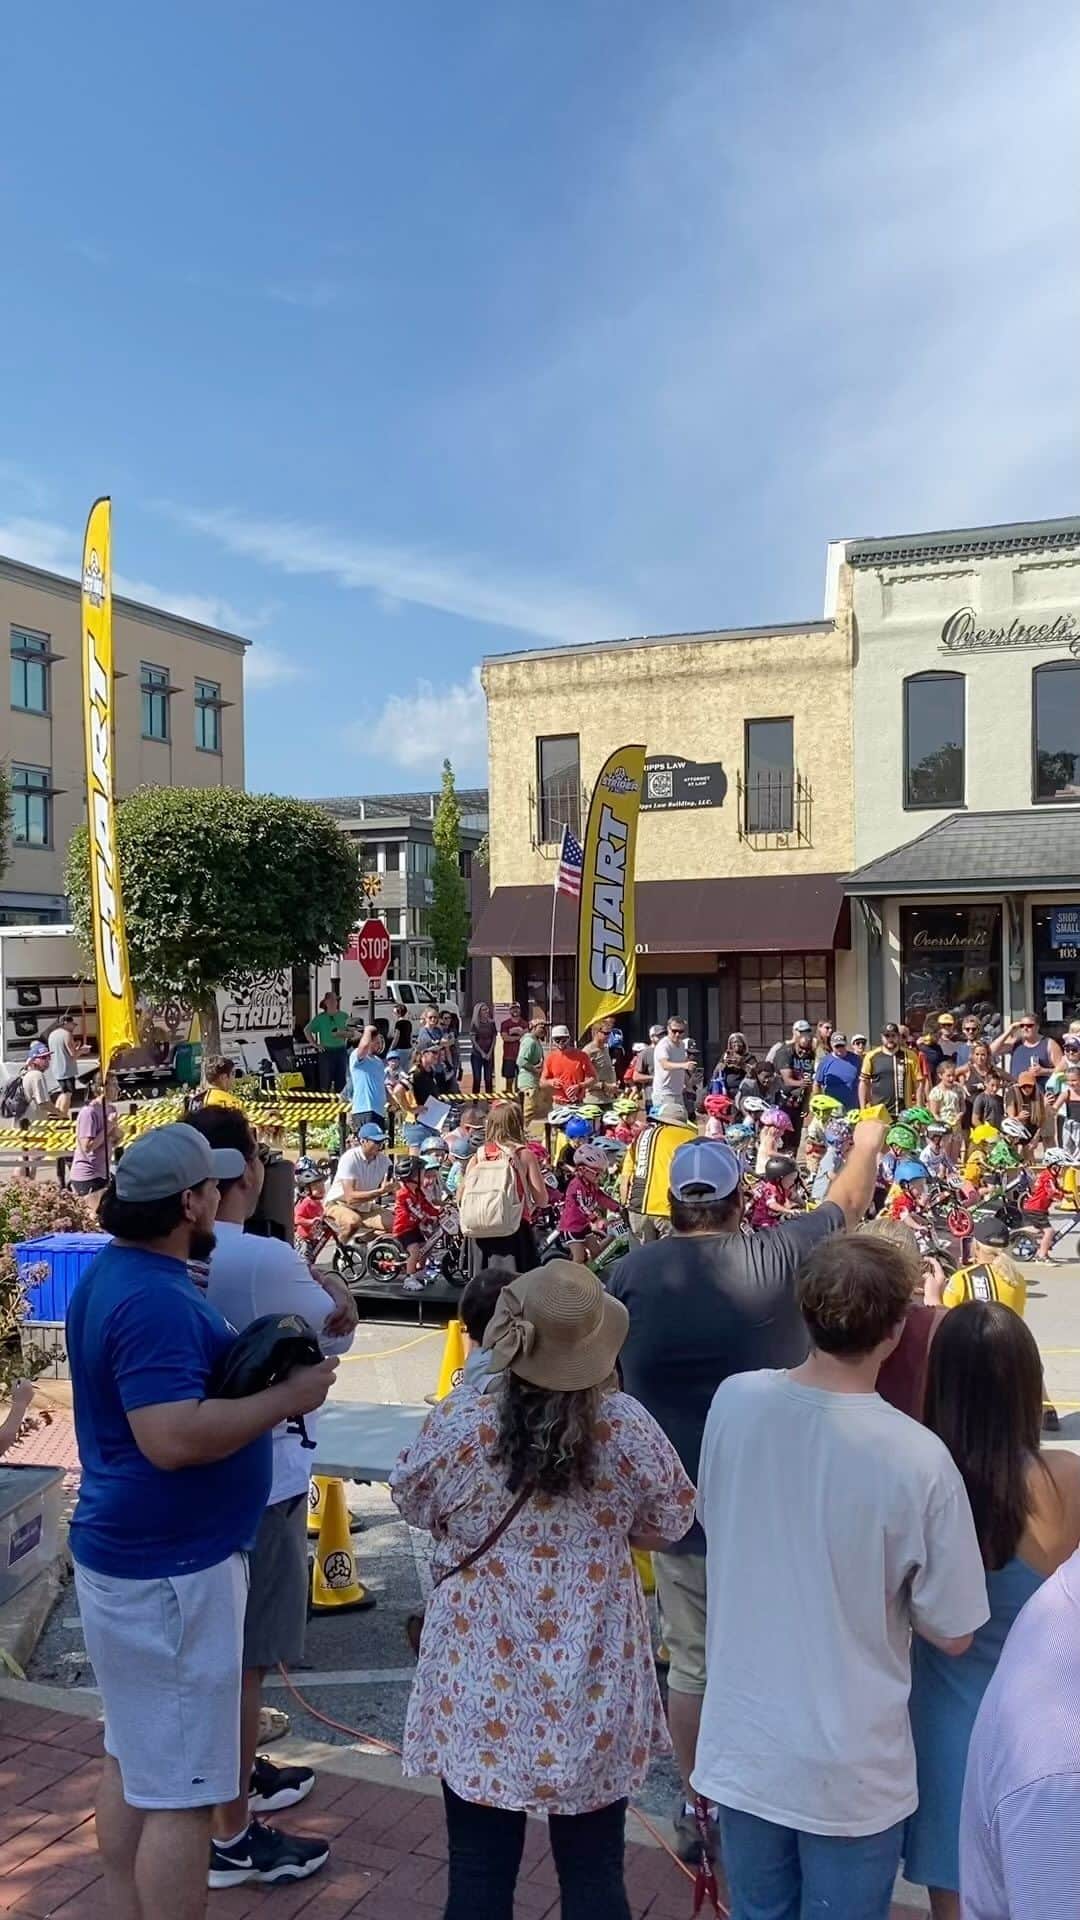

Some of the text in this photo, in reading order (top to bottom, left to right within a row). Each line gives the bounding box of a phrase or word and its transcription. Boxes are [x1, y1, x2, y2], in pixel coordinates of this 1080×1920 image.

[666, 761, 687, 770] LAW
[589, 803, 628, 996] START
[1058, 912, 1078, 923] SHOP
[1055, 923, 1080, 933] SMALL
[360, 937, 389, 960] STOP
[1059, 948, 1077, 959] 103
